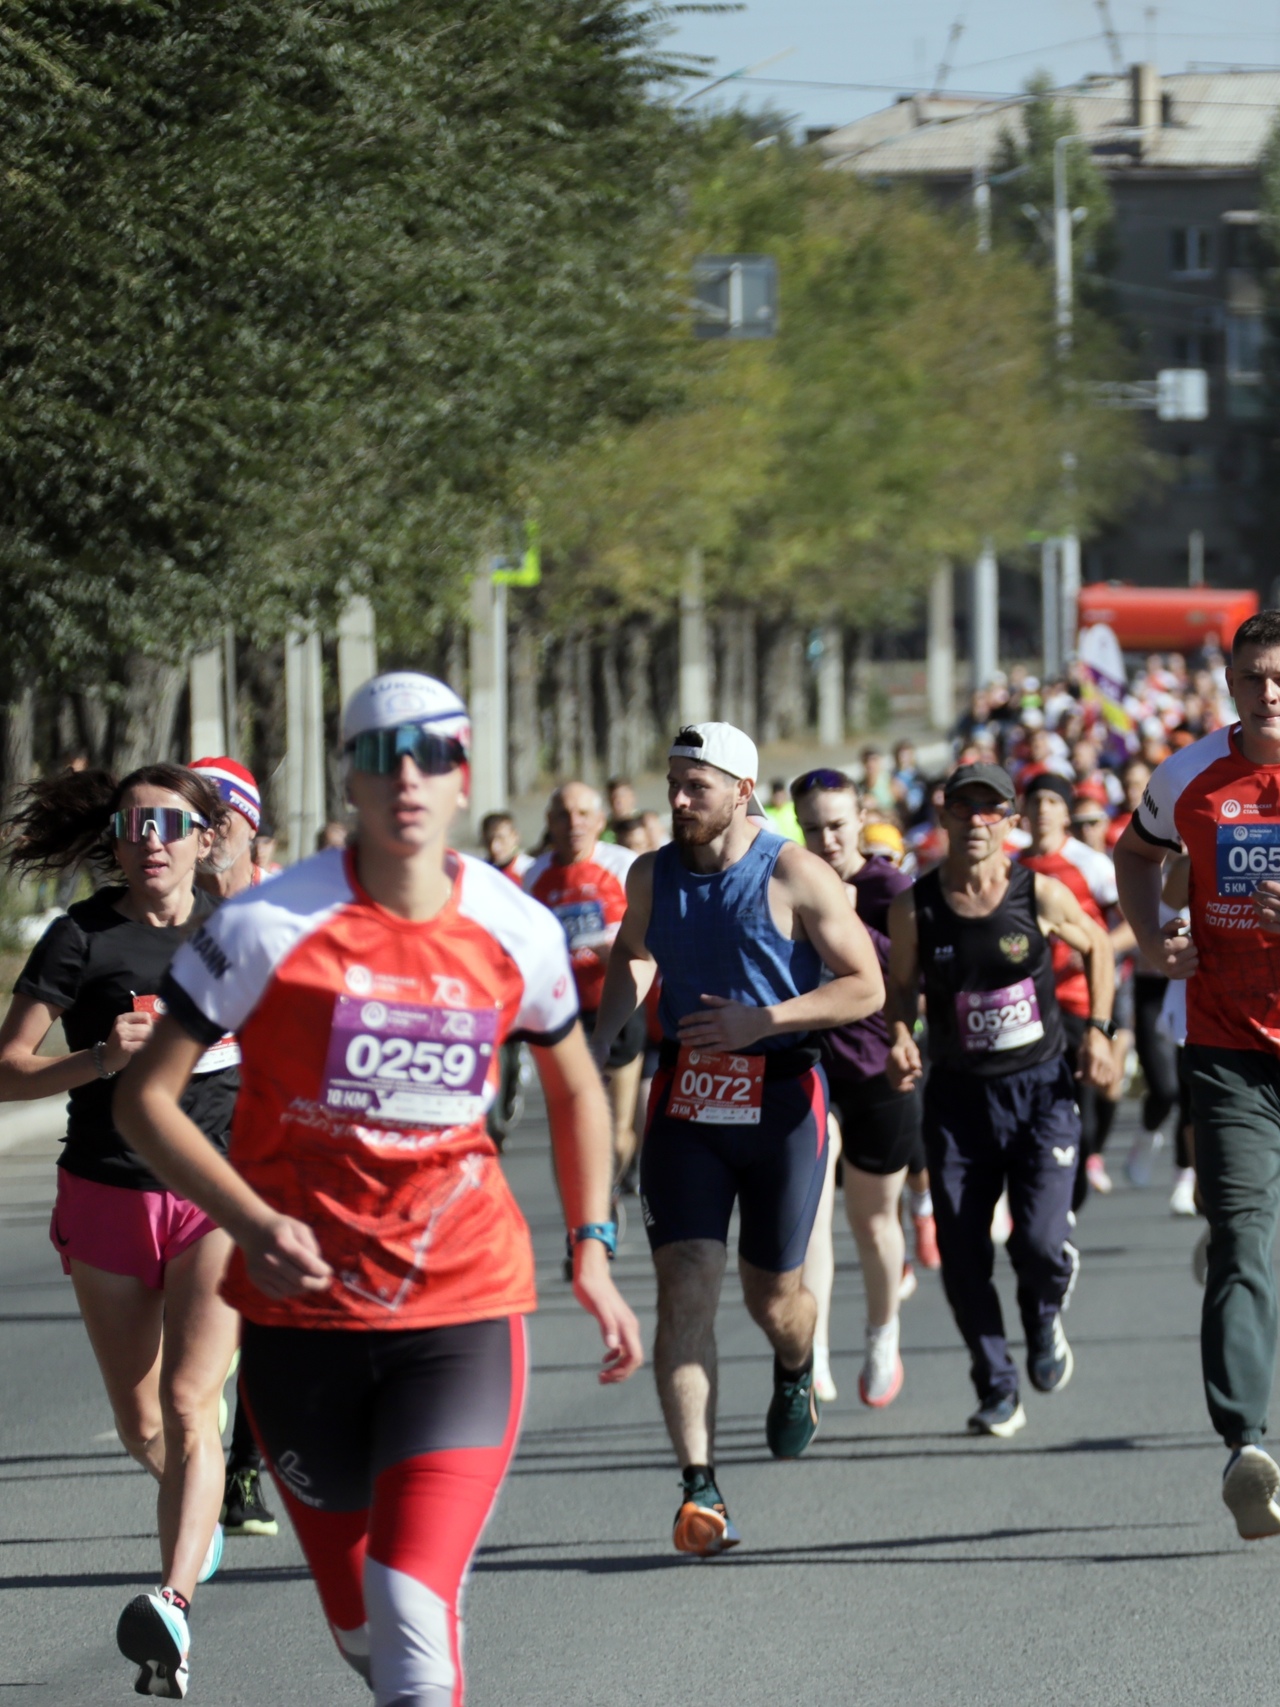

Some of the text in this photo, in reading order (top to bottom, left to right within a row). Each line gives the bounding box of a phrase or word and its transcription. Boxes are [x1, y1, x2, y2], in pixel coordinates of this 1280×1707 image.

[1225, 883, 1230, 892] 5
[967, 999, 1032, 1033] 0529
[345, 1033, 477, 1087] 0259
[326, 1088, 342, 1106] 10
[681, 1069, 752, 1102] 0072
